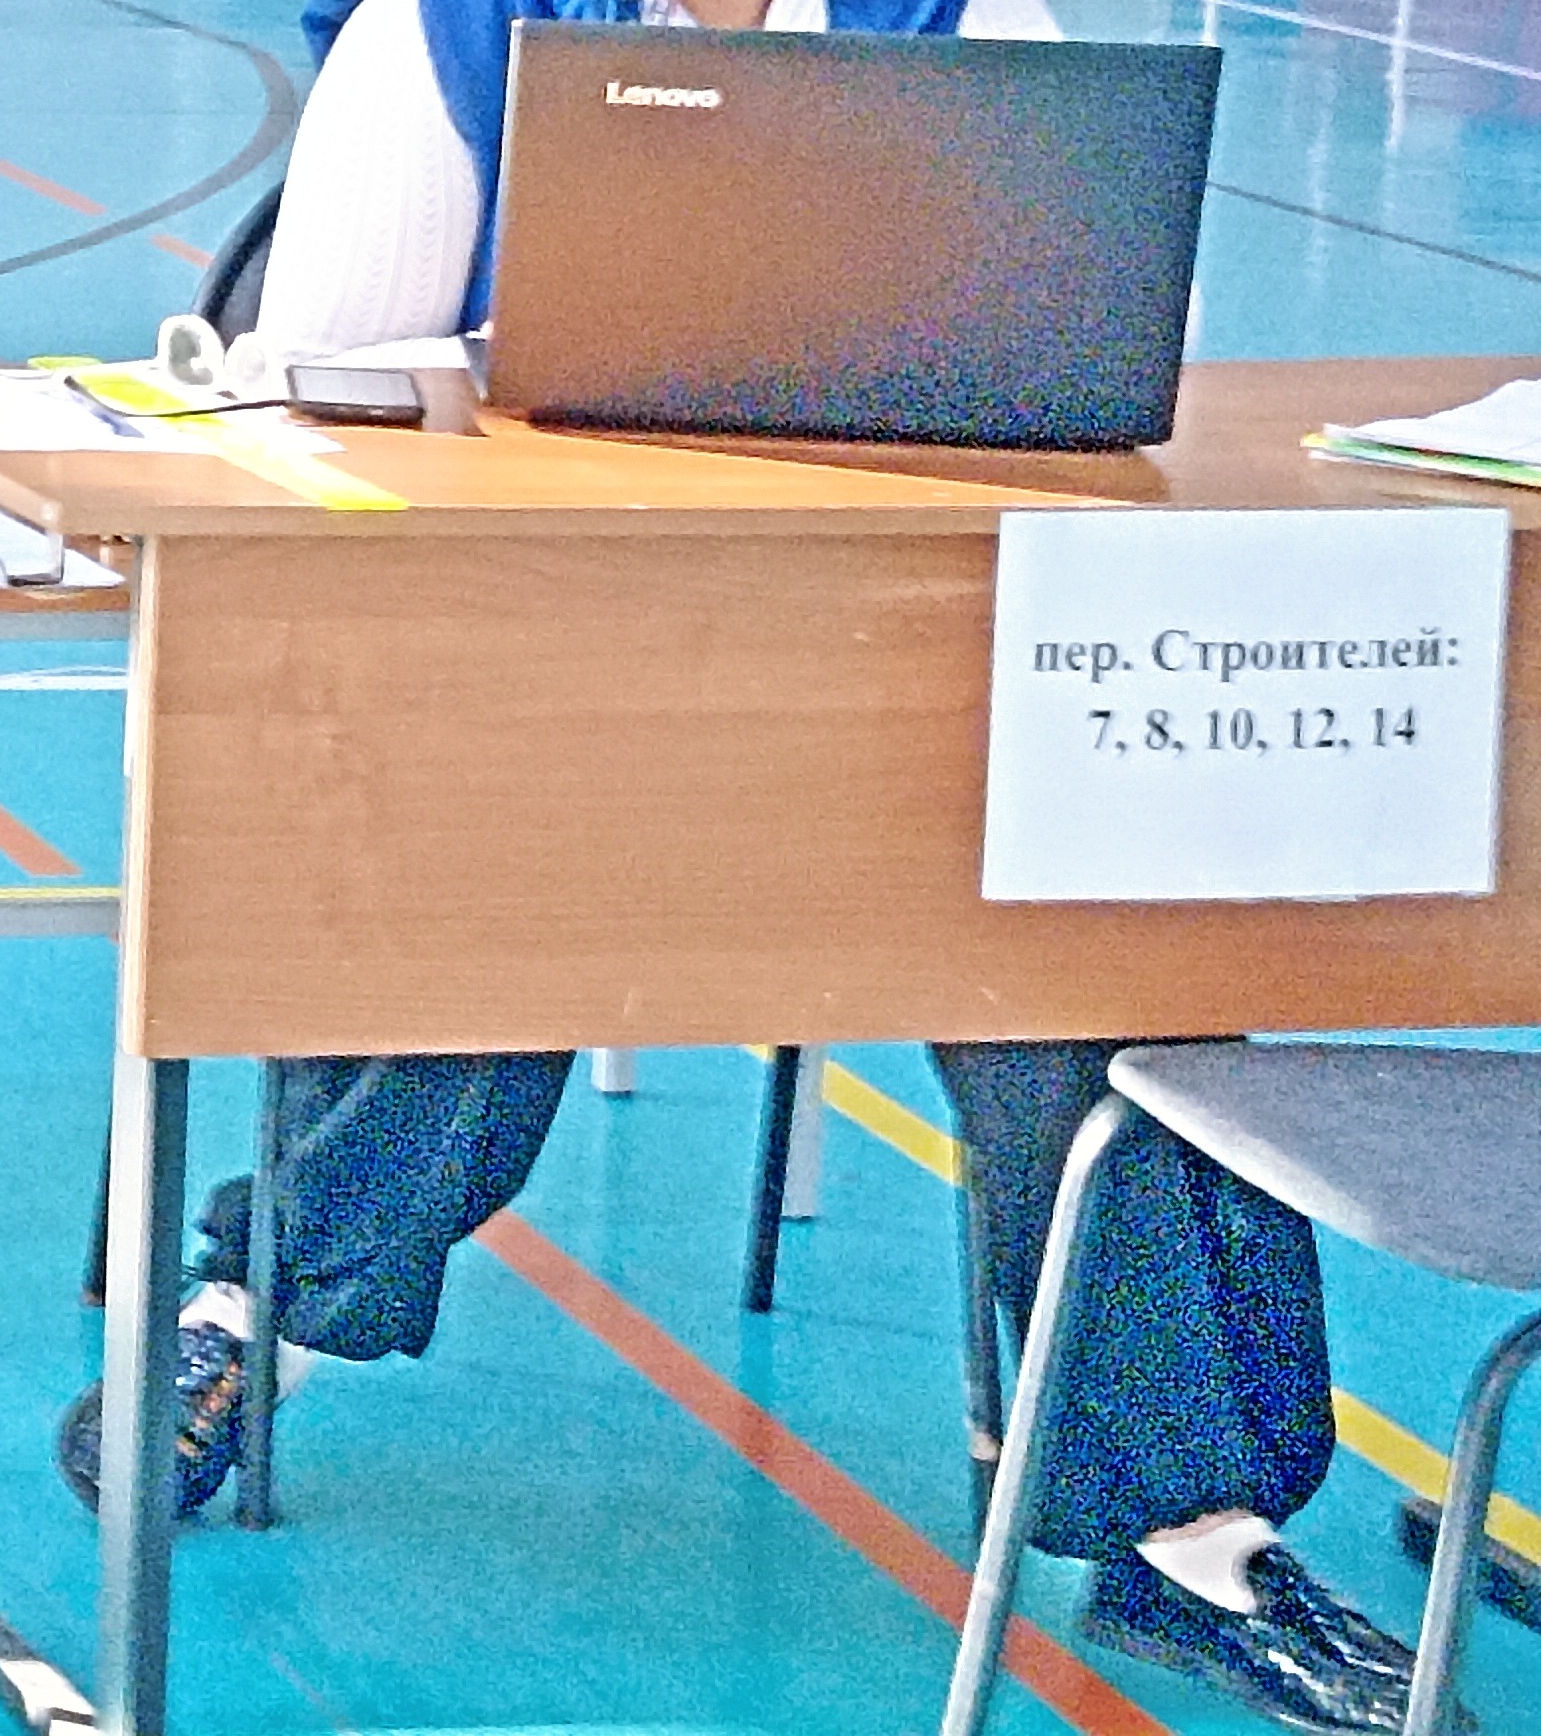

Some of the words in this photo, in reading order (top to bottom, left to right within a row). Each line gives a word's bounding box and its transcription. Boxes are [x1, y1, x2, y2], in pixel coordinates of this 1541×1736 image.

[605, 81, 720, 107] Lenovo
[1033, 641, 1134, 685] пер.
[1150, 626, 1460, 684] Строителей:
[1087, 708, 1128, 755] 7,
[1143, 707, 1186, 755] 8,
[1206, 707, 1270, 755] 10,
[1289, 707, 1352, 754] 12,
[1371, 706, 1419, 748] 14
